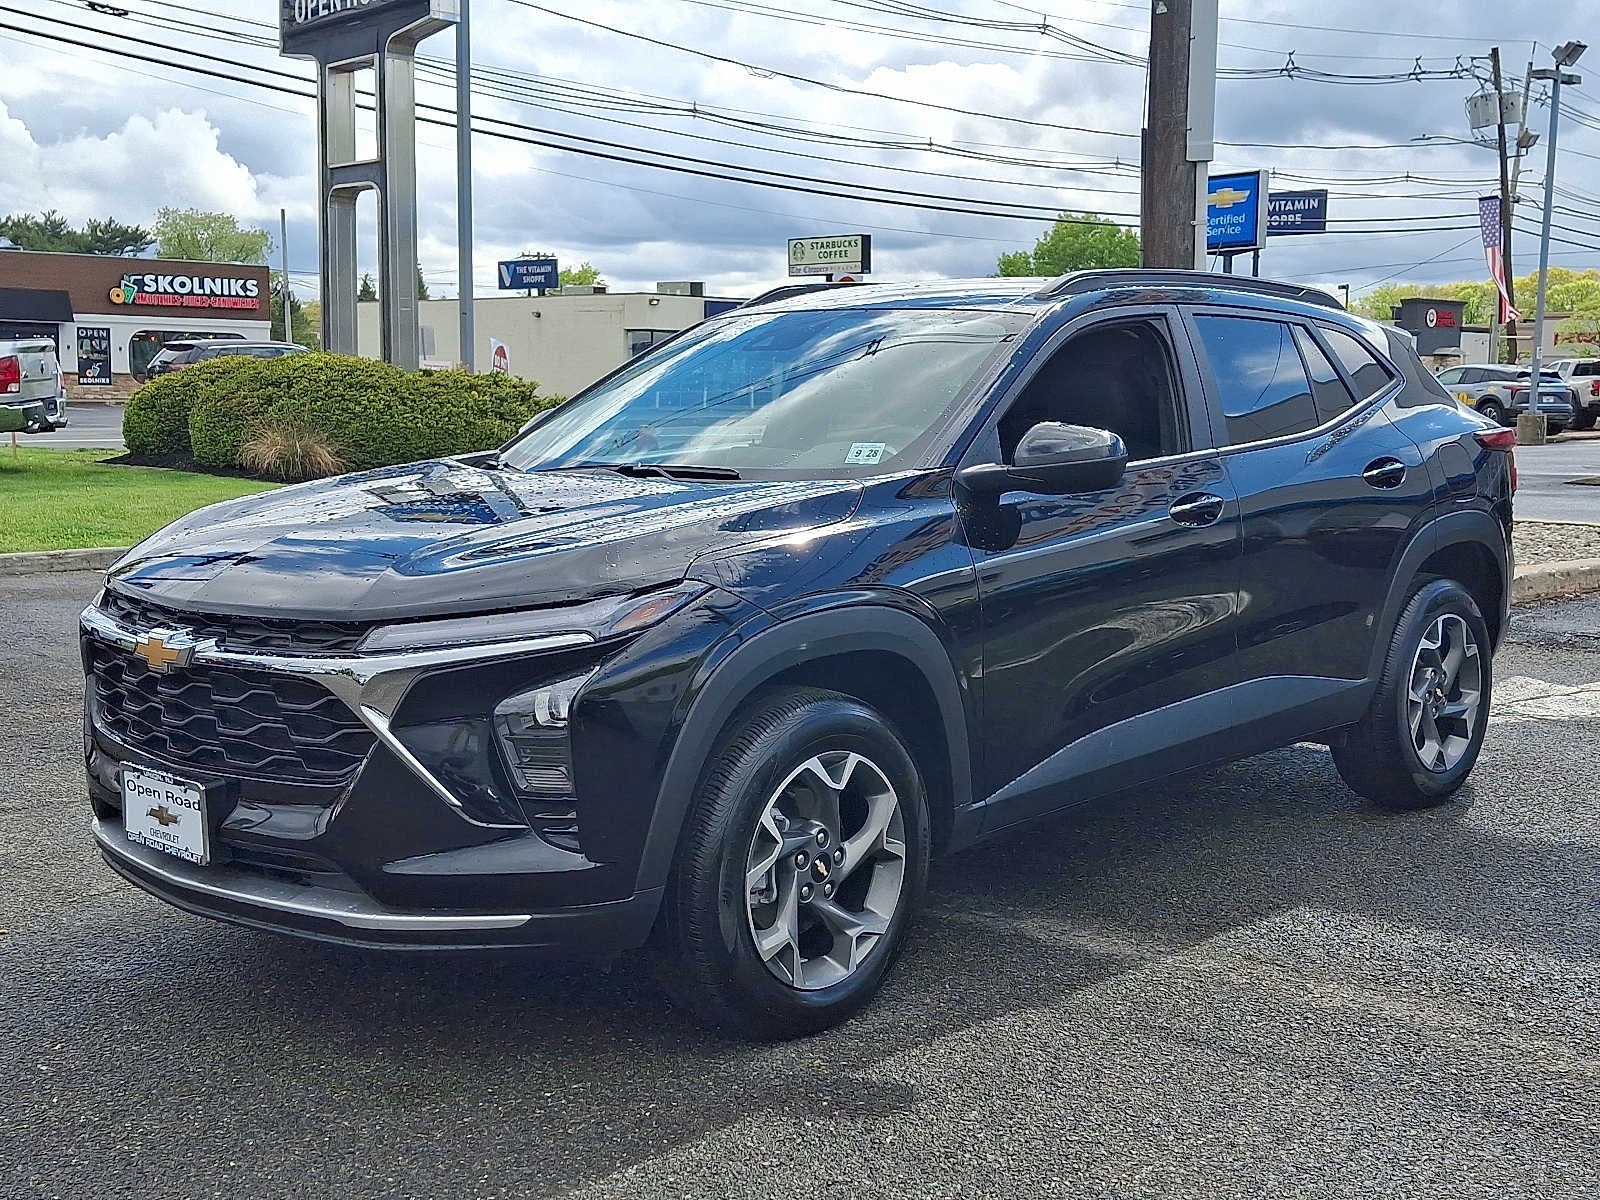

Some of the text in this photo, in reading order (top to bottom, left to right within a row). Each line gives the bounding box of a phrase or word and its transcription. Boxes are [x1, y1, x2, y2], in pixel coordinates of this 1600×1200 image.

[1267, 198, 1319, 212] VITAMIN
[810, 239, 859, 250] STARBUCKS
[817, 249, 849, 259] COFFEE
[528, 265, 552, 273] VITAMIN
[143, 274, 259, 297] SKOLNIKS
[78, 328, 107, 338] OPEN
[855, 449, 879, 458] 9 28
[126, 778, 201, 812] Open Road
[149, 827, 180, 844] CHEVROLET
[127, 832, 201, 863] OPEN ROAD CHEVROLET
